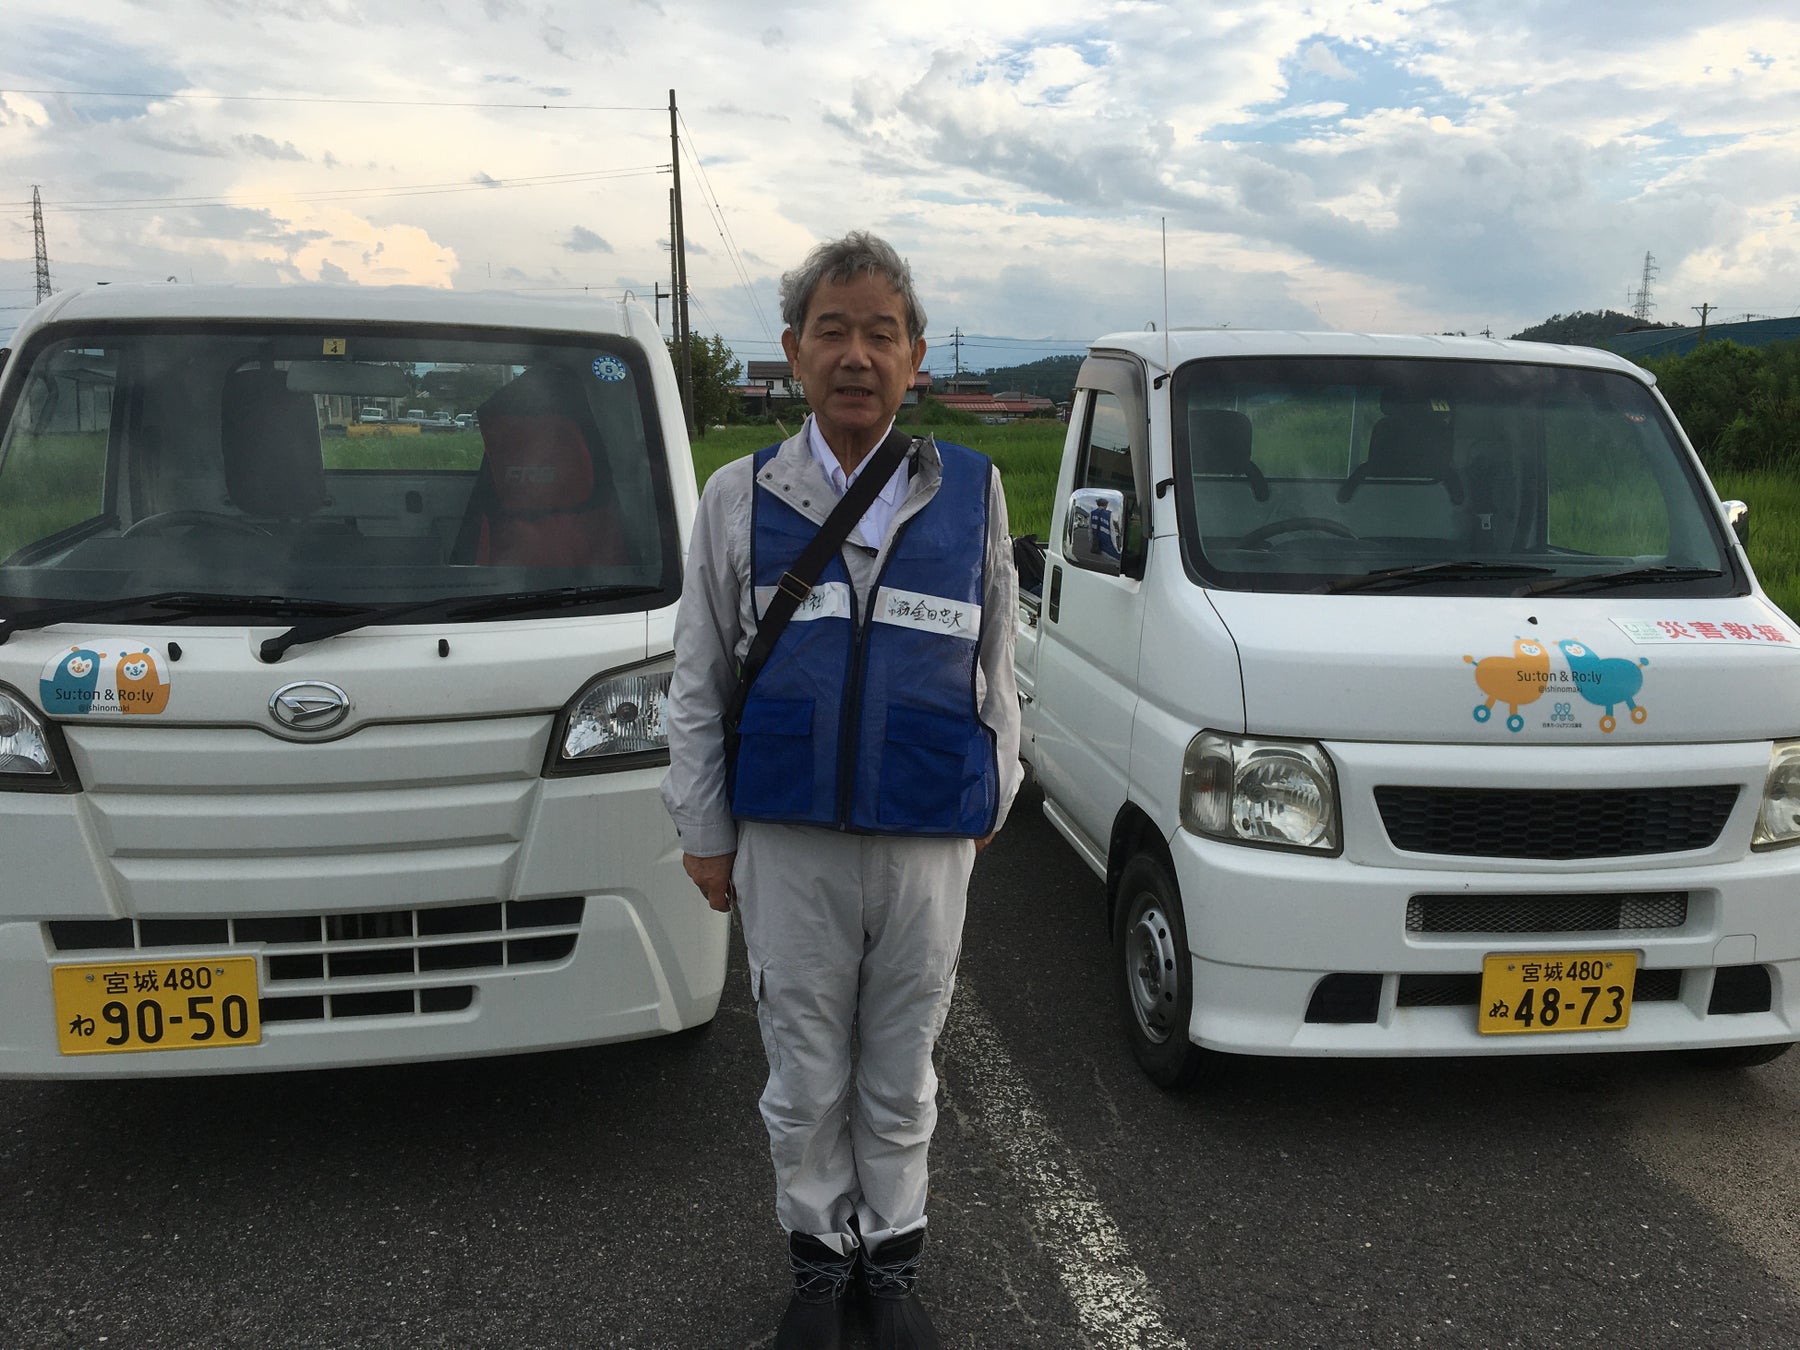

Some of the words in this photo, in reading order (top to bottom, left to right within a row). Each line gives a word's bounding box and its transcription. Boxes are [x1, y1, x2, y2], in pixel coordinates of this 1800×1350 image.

[1656, 619, 1792, 643] 災害救援
[1516, 670, 1556, 683] Su:ton
[1560, 671, 1569, 682] &
[1572, 670, 1603, 685] Ro:ly
[55, 687, 101, 701] Su:ton
[104, 689, 115, 701] &
[118, 688, 154, 704] Ro:ly
[1538, 685, 1583, 694] @ishinomaki
[78, 703, 130, 713] @ishinomaki
[1488, 999, 1510, 1018] ぬ
[1514, 986, 1625, 1027] 48-73
[69, 1014, 96, 1037] ね
[102, 994, 249, 1046] 90-50
